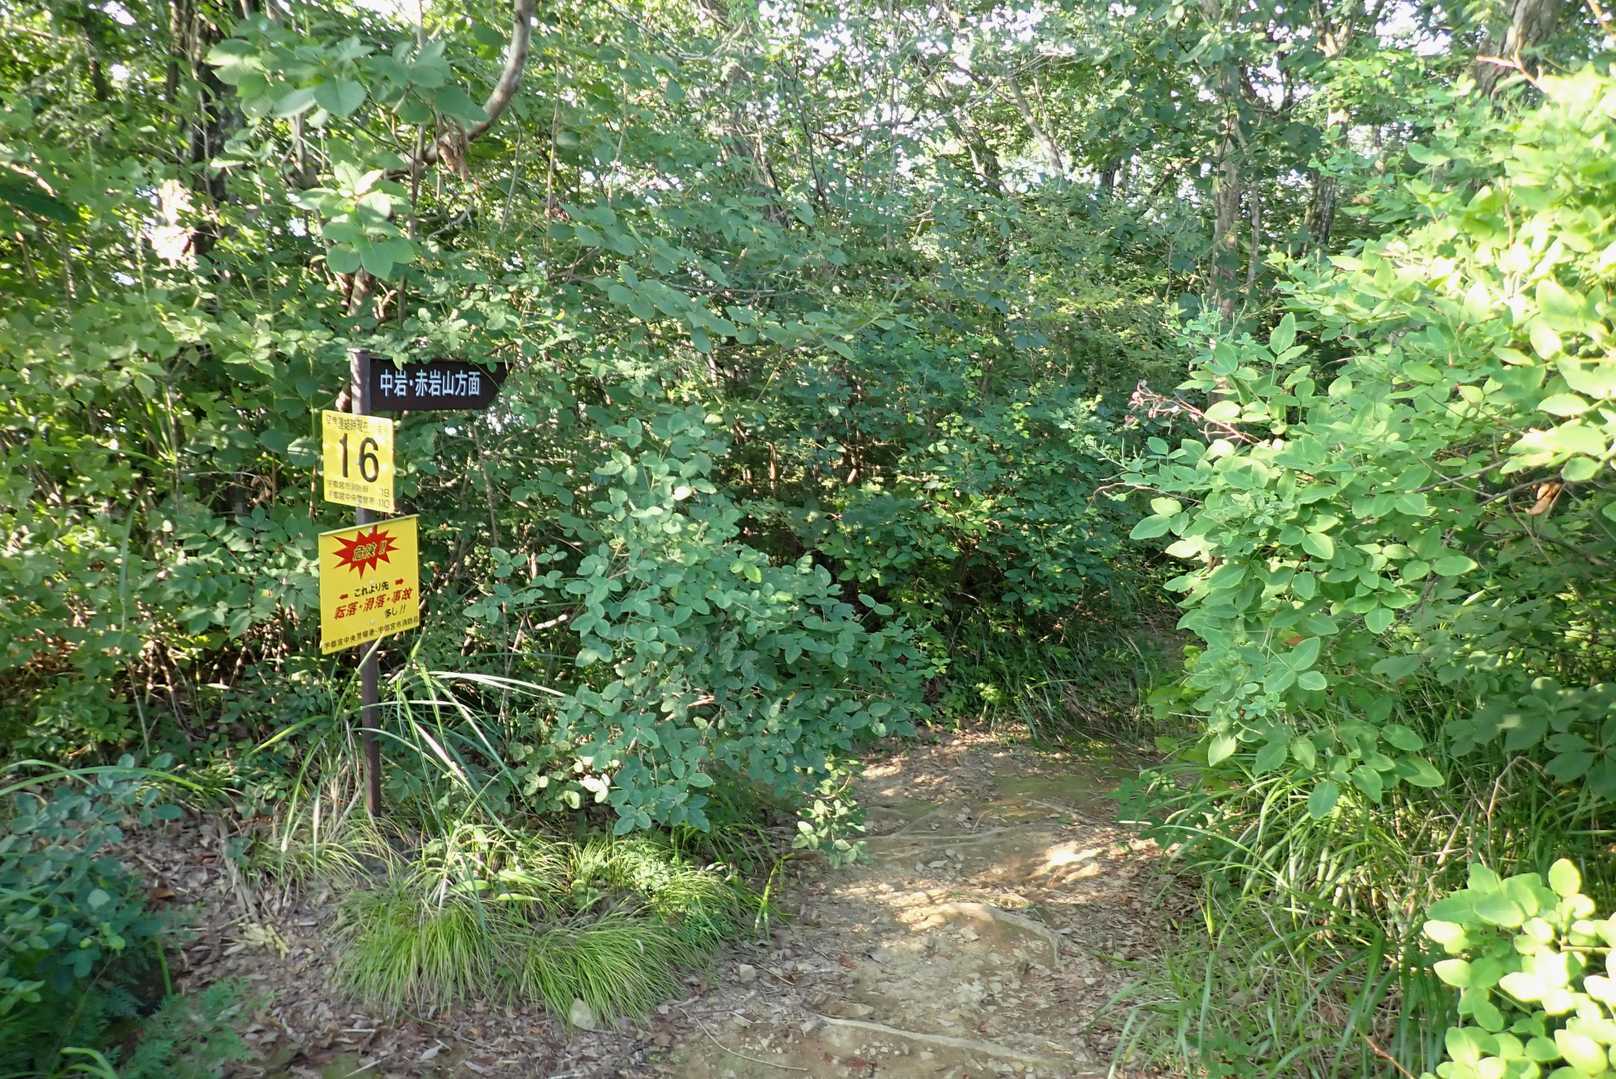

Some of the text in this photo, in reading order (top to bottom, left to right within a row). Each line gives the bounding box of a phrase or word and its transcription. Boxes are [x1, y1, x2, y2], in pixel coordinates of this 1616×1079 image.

[379, 369, 481, 397] 中岩・赤岩山方面
[339, 432, 379, 483] 16
[354, 581, 390, 597] これより先
